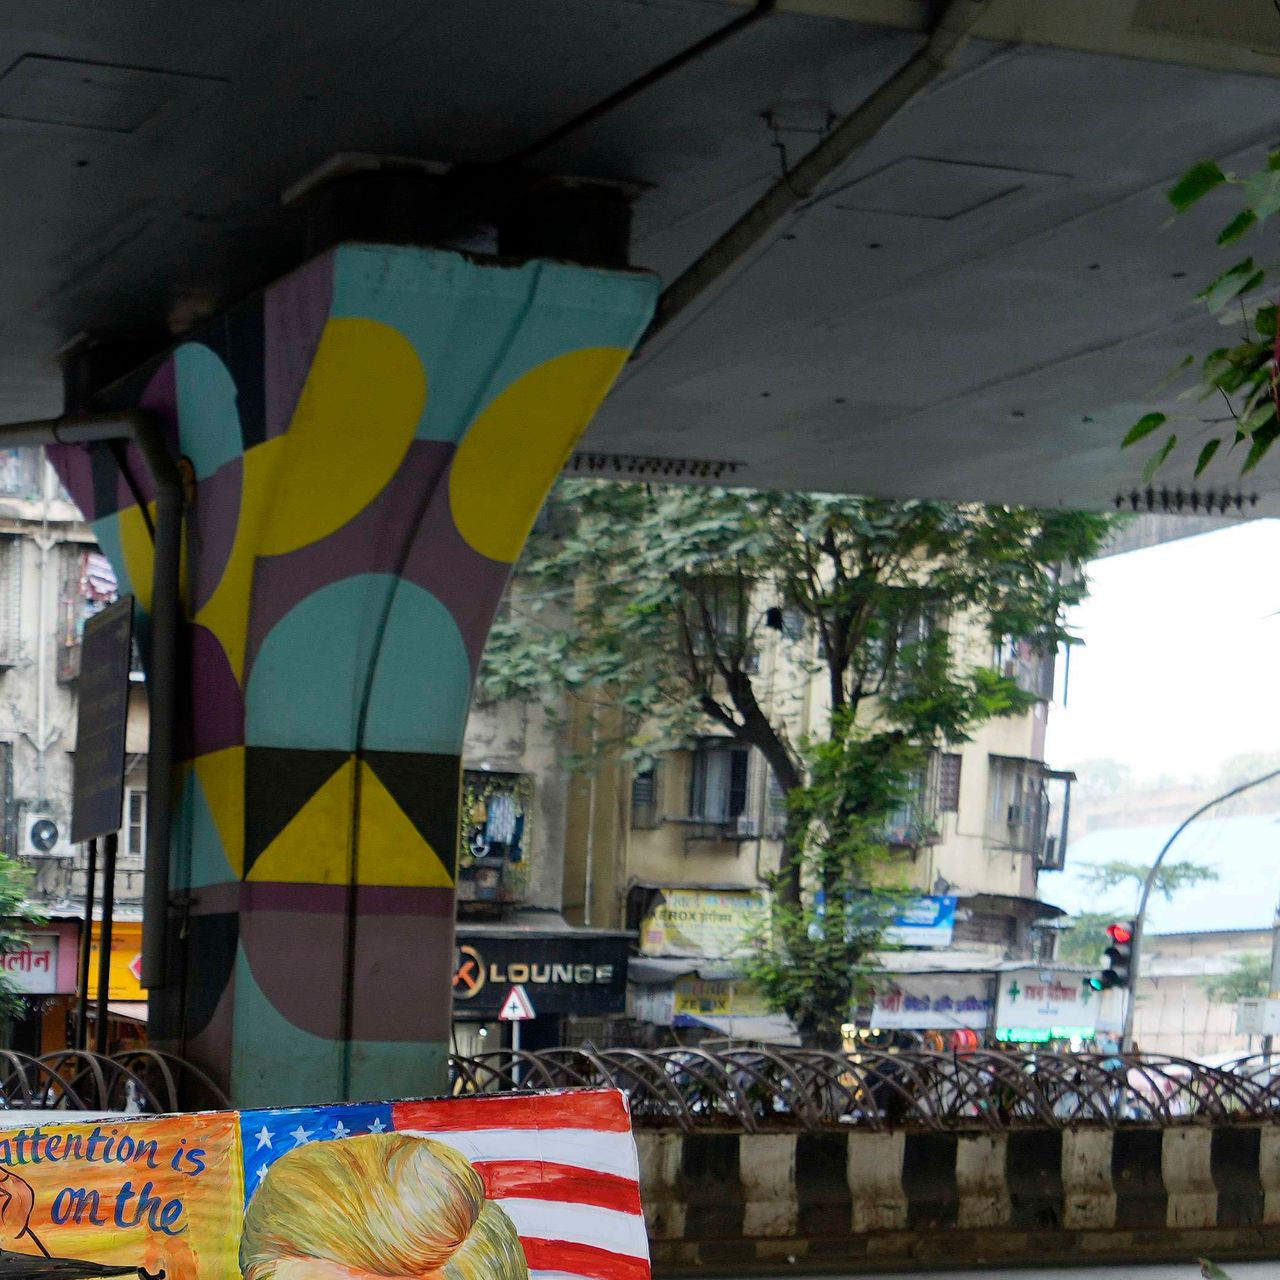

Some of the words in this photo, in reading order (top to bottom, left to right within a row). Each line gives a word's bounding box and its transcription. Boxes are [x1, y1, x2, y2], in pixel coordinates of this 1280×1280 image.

[490, 963, 614, 984] LOUNGE
[171, 1138, 207, 1177] is
[51, 1186, 106, 1226] on
[113, 1181, 189, 1236] the
